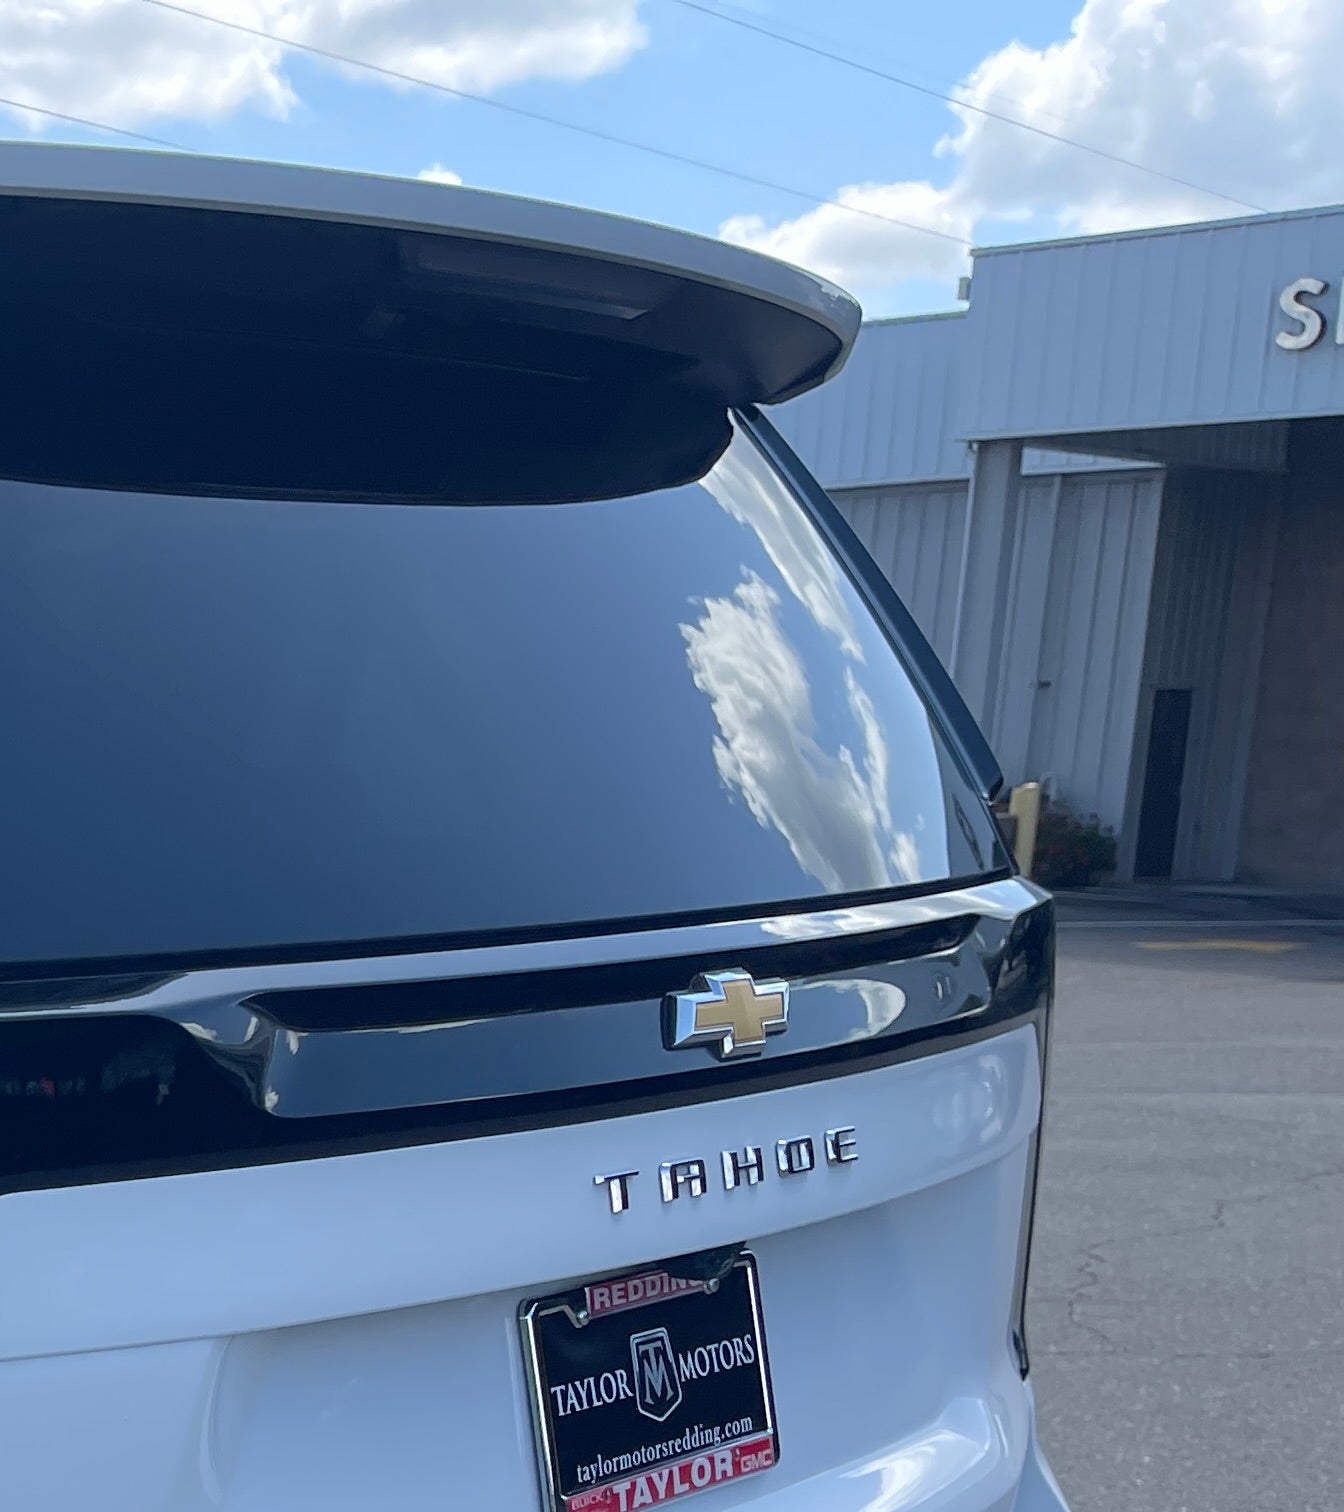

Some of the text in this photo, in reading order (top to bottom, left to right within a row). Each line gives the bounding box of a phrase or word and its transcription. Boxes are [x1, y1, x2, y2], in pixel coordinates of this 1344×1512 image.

[592, 1125, 859, 1214] TAHOE
[550, 1368, 634, 1417] TAYLOR
[677, 1333, 756, 1383] MOTORS
[576, 1416, 754, 1484] taylormotorsredding.com
[740, 1449, 774, 1473] GMC
